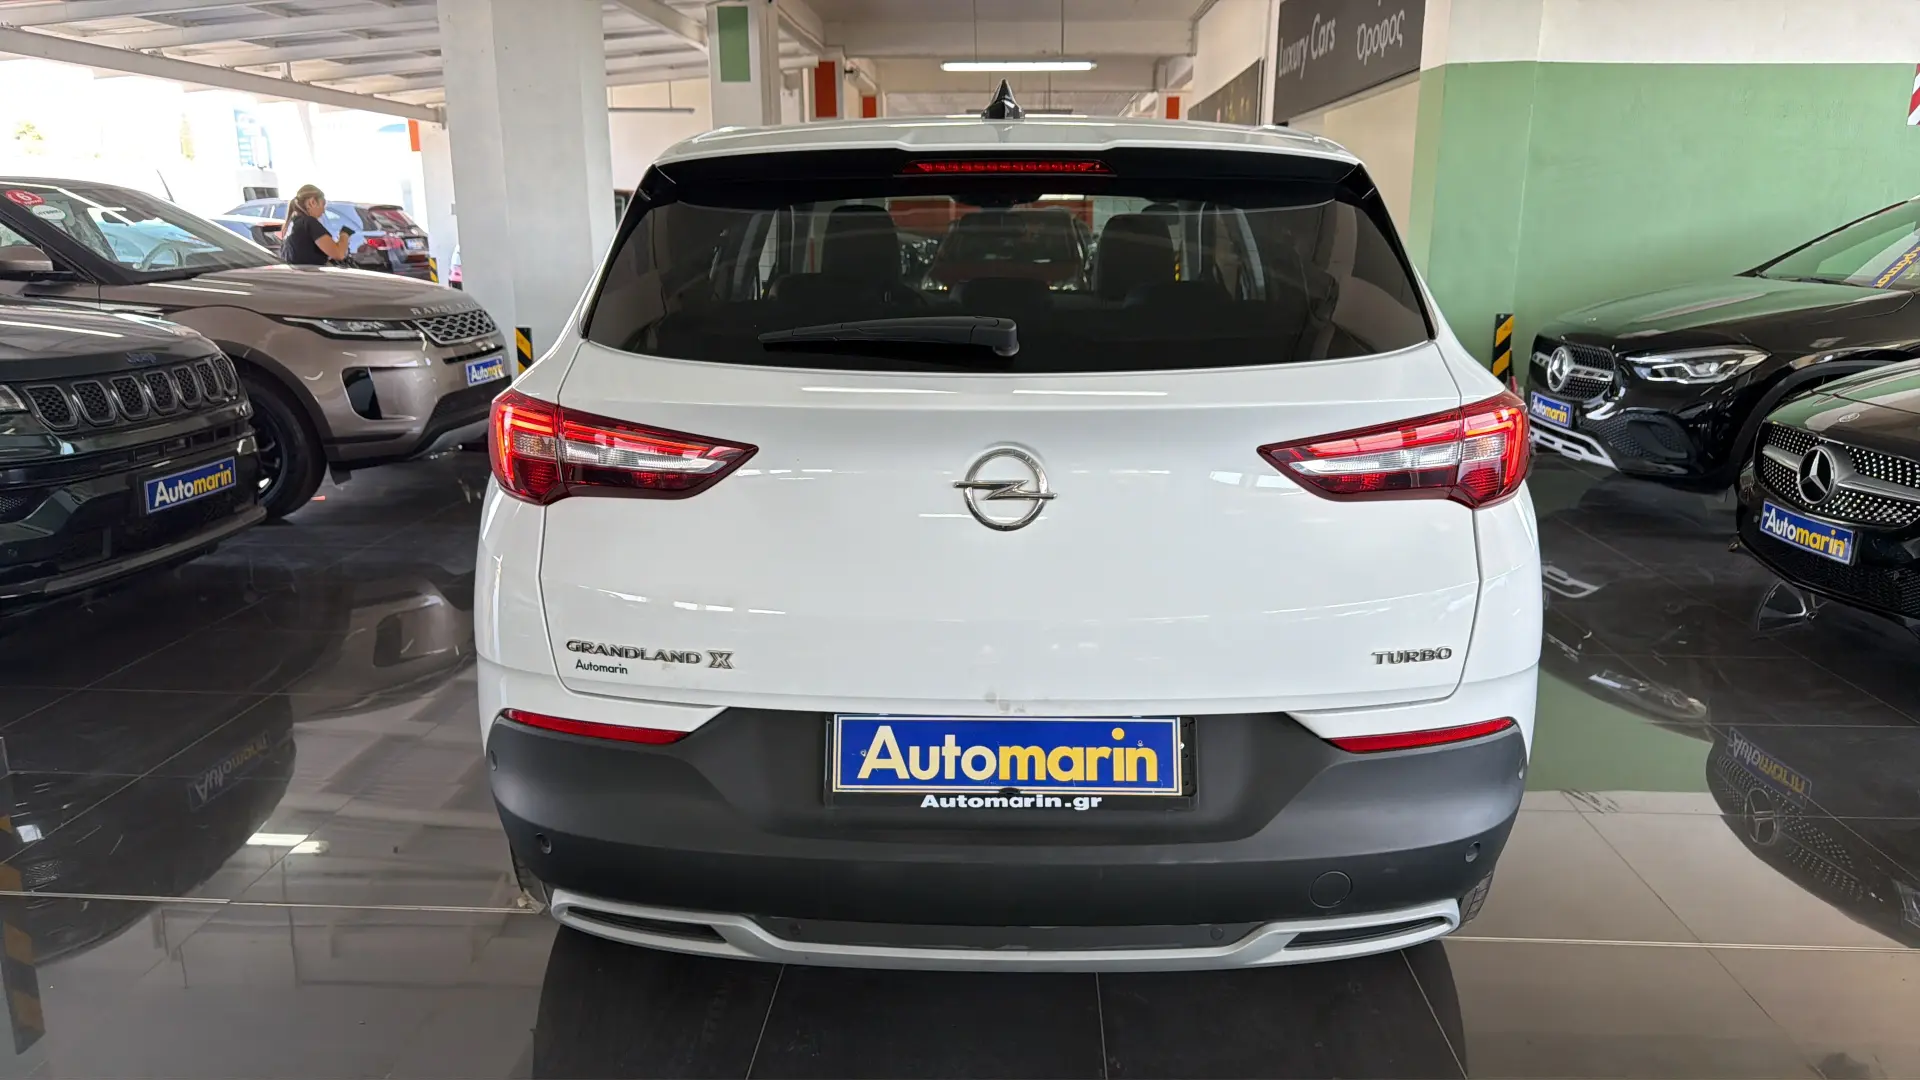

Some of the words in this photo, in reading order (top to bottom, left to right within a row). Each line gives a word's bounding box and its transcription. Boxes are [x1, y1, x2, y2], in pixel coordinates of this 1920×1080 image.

[1311, 13, 1336, 60] Cars
[154, 464, 231, 507] Automarin
[1765, 508, 1846, 557] Automarin
[566, 640, 701, 664] GRANDLAND
[708, 650, 734, 670] X
[575, 659, 628, 675] Automarin
[1371, 647, 1452, 665] TURBO
[857, 725, 1158, 782] Automarin
[920, 794, 1102, 811] Automarin.gr
